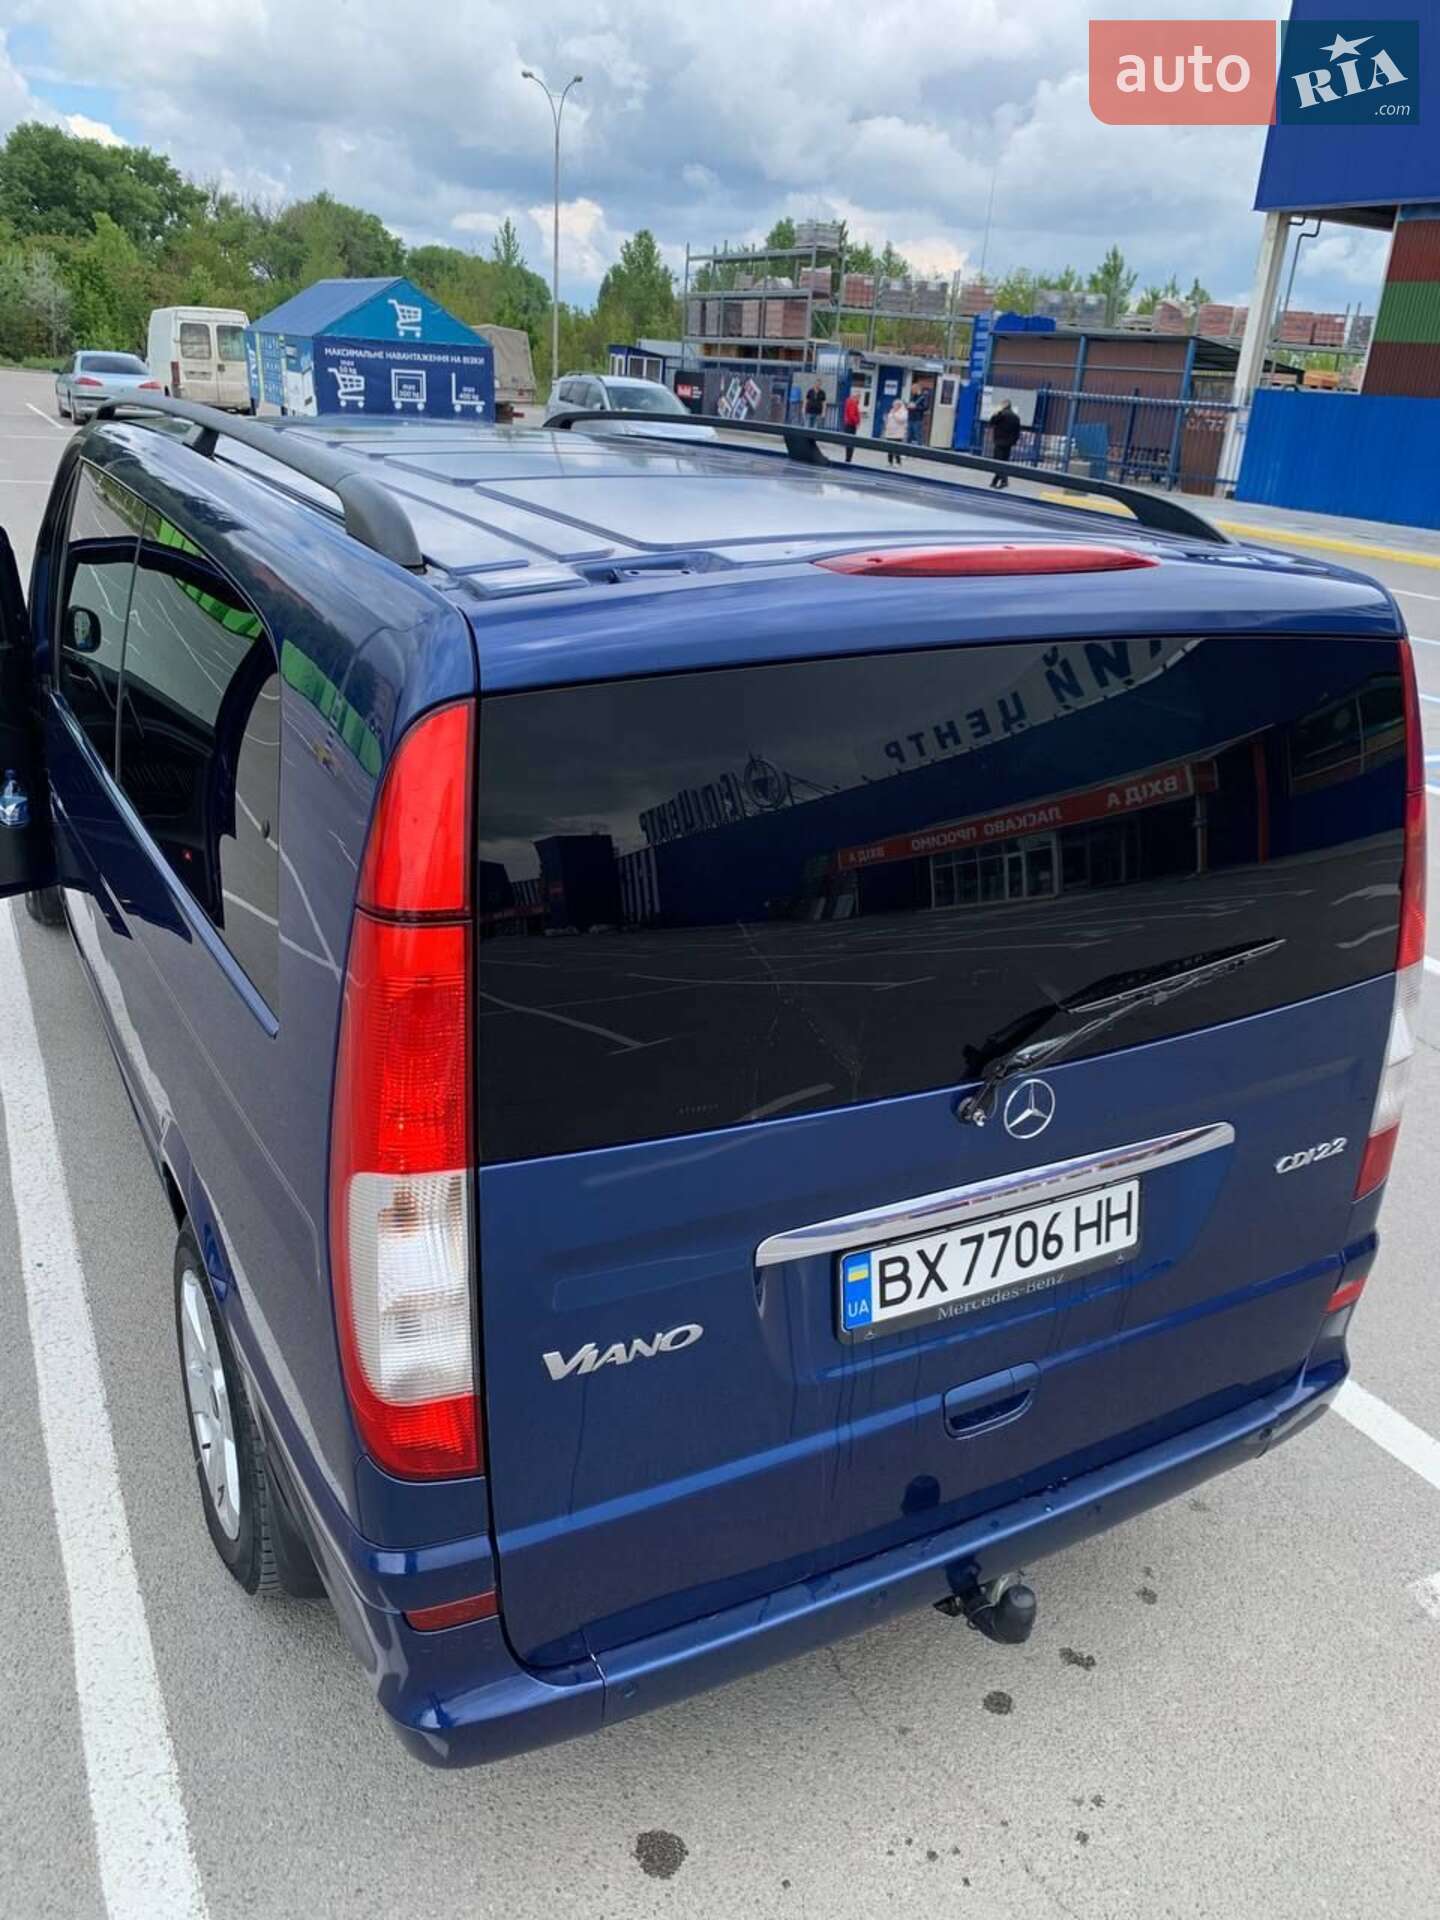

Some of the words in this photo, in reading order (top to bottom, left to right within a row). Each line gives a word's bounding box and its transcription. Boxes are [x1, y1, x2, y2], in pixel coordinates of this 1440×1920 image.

[324, 347, 385, 359] МАКСИМАЛЬНЕ
[385, 350, 450, 363] НАВАНТАЖЕННЯ
[450, 354, 461, 364] НА
[878, 1243, 949, 1309] BX
[960, 1211, 1063, 1287] 7706
[1074, 1190, 1132, 1253] HH
[847, 1299, 870, 1318] UA
[936, 1272, 1065, 1321] Mercedes-Benz
